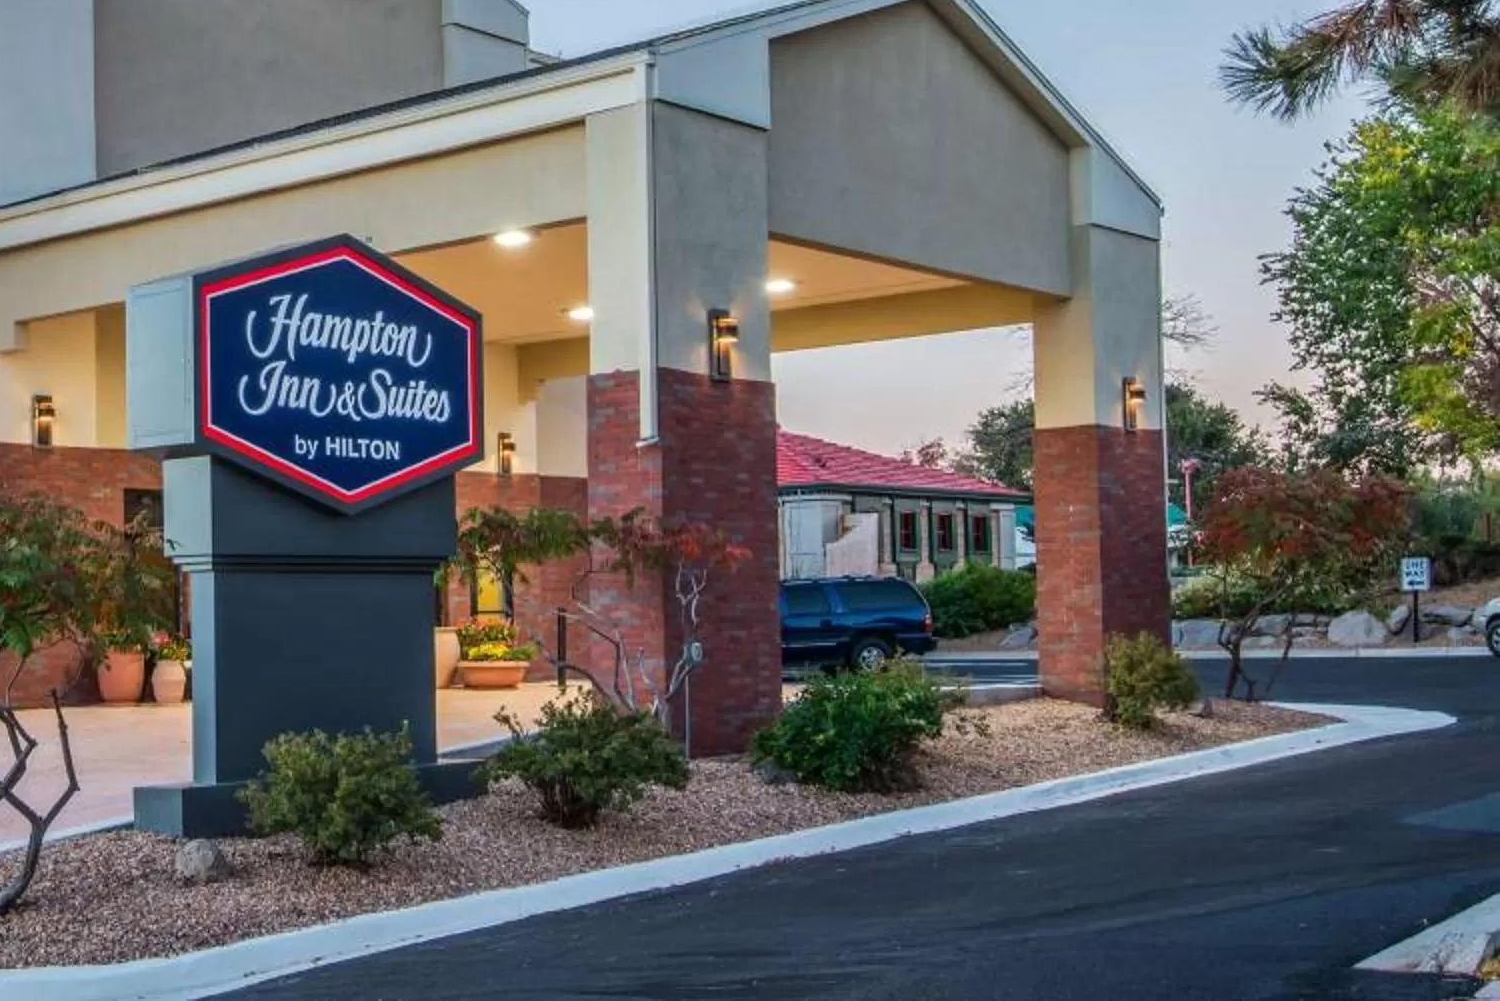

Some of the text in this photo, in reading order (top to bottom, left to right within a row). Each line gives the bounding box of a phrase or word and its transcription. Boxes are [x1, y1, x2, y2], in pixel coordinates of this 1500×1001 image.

[246, 293, 432, 367] Hampton
[238, 360, 337, 417] Inn
[358, 368, 450, 423] Suites
[295, 434, 400, 460] by HILTON
